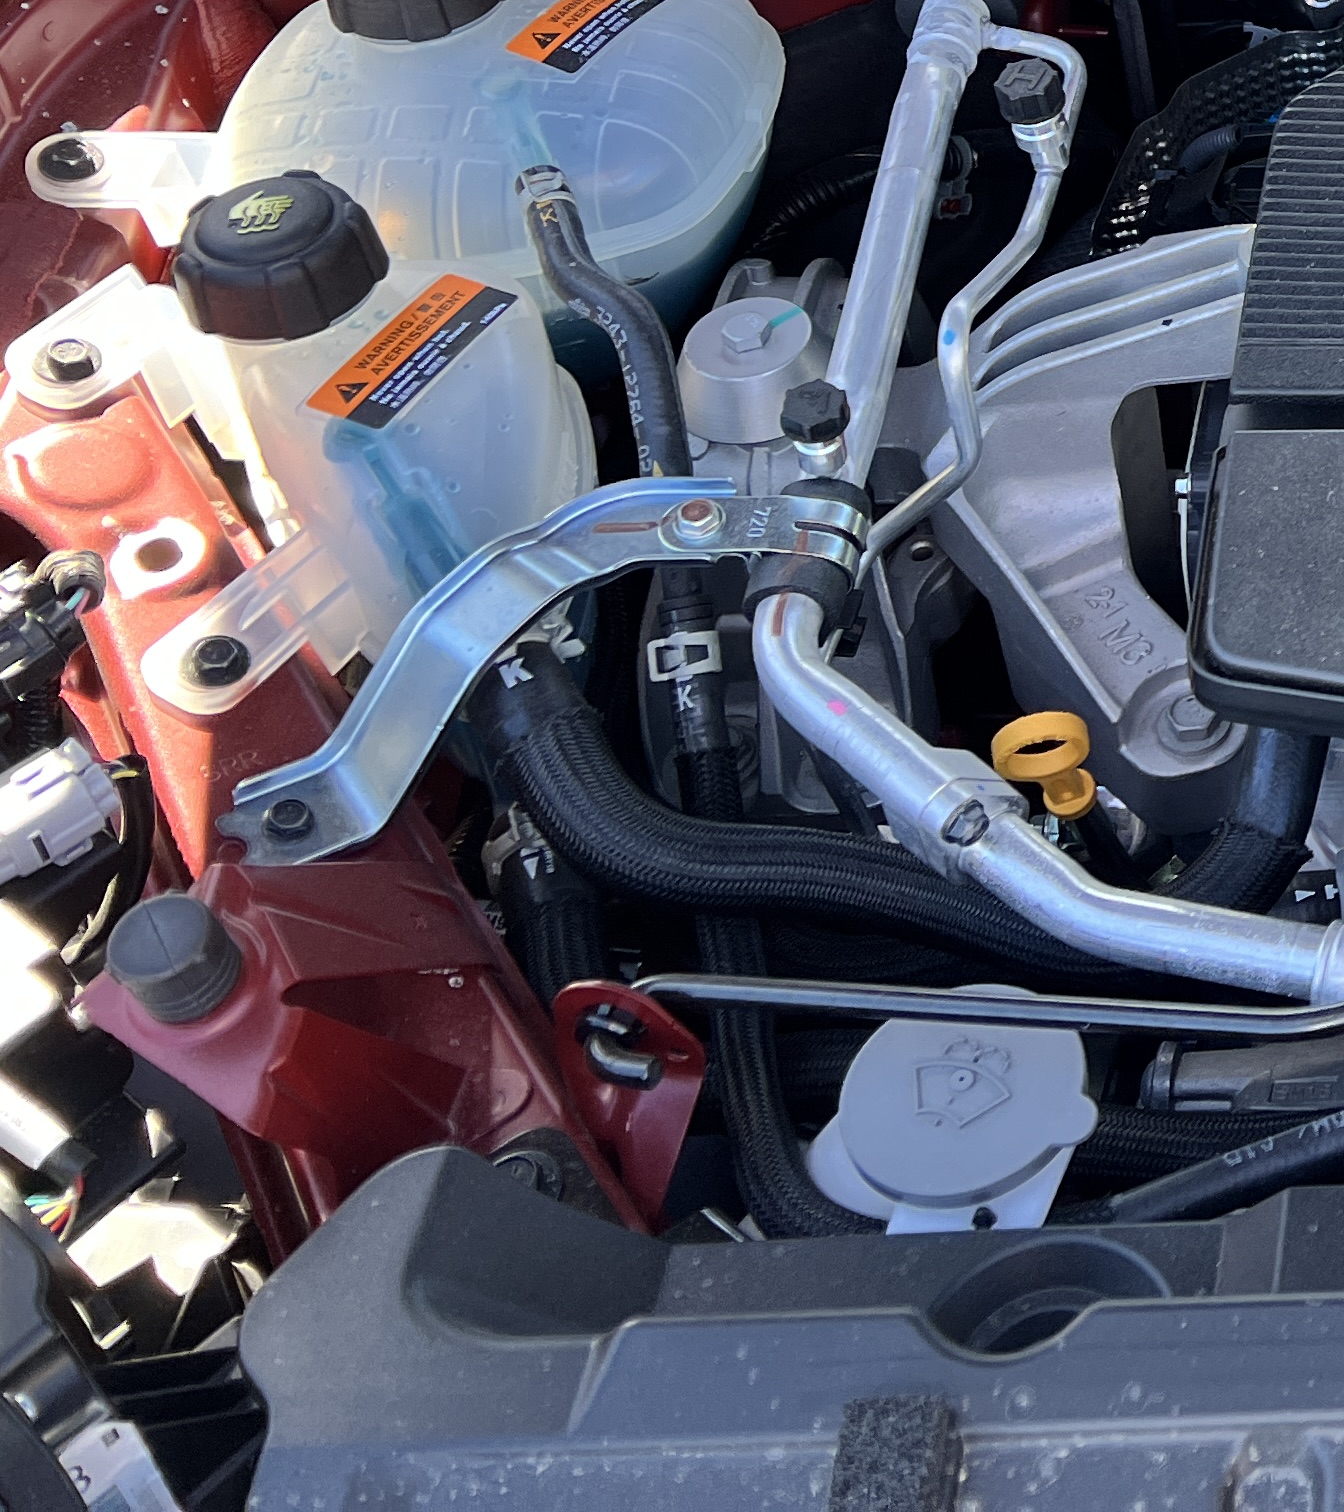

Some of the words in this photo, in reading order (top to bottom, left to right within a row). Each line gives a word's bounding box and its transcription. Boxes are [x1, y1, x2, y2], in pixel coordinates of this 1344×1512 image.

[355, 320, 413, 371] WARNING
[370, 290, 466, 376] AVERTISSEMENT
[499, 657, 534, 689] K
[677, 683, 695, 711] K
